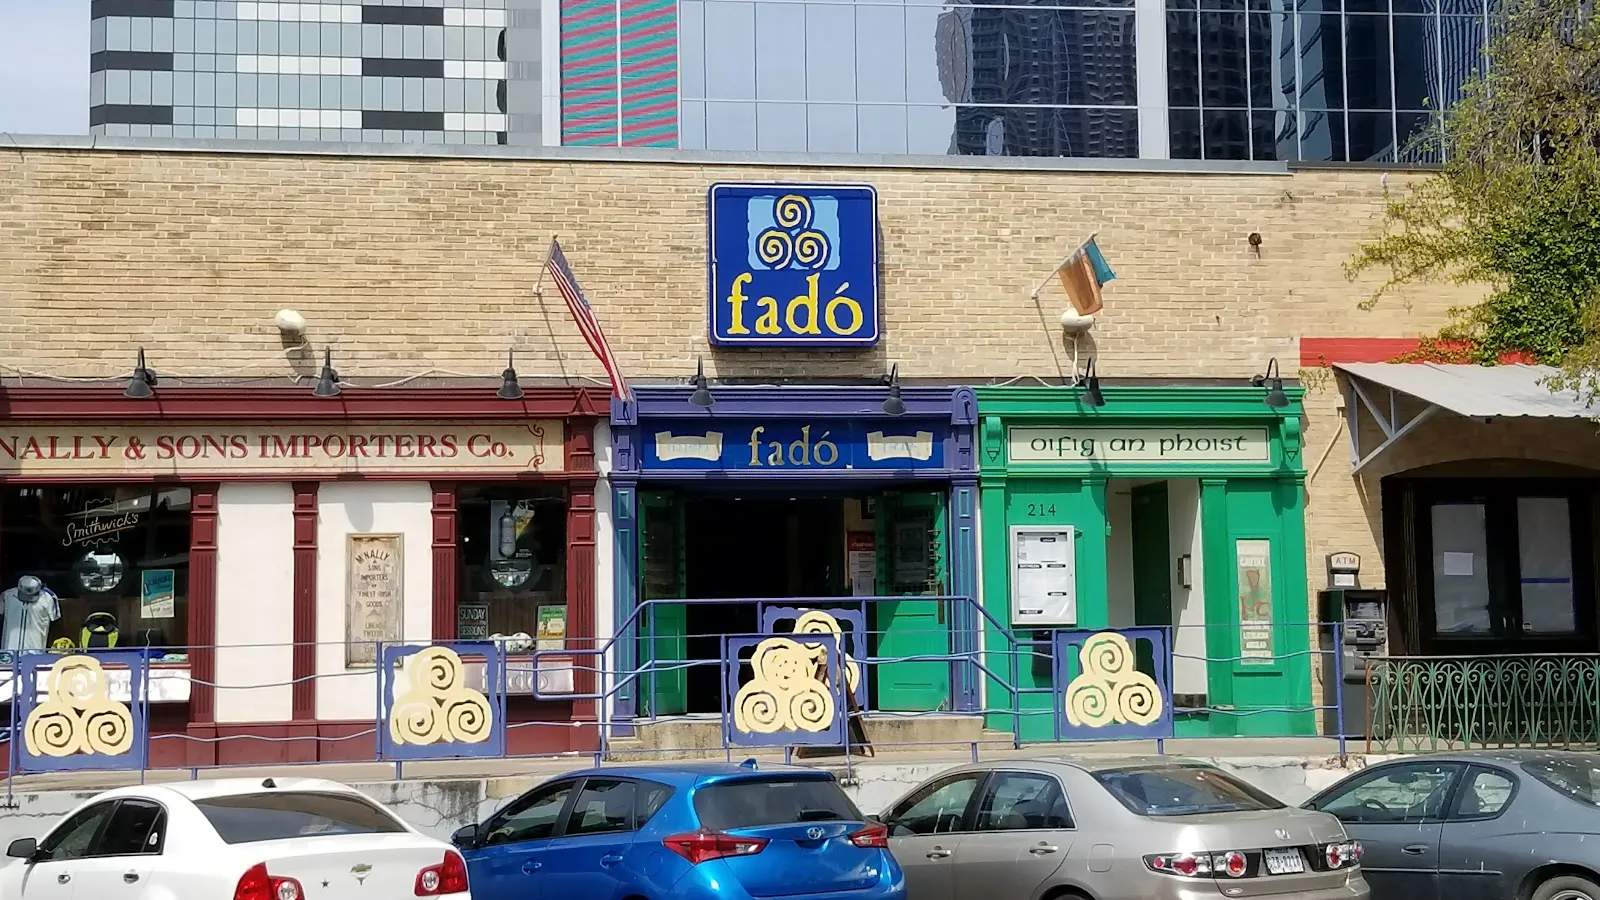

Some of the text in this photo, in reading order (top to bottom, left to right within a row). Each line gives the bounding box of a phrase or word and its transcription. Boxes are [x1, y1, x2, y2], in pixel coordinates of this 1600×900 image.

[727, 272, 864, 336] fadó
[0, 434, 515, 460] NALLY & SONS IMPORTERS Co.
[748, 425, 839, 467] fadó
[1030, 434, 1248, 457] oifig an phoist
[1027, 503, 1056, 517] 214
[62, 512, 139, 546] Smithwick's
[1335, 556, 1356, 565] ATM
[360, 573, 389, 581] IMPORTERS
[460, 608, 486, 620] SUNDAY
[460, 625, 486, 636] SESSIONS
